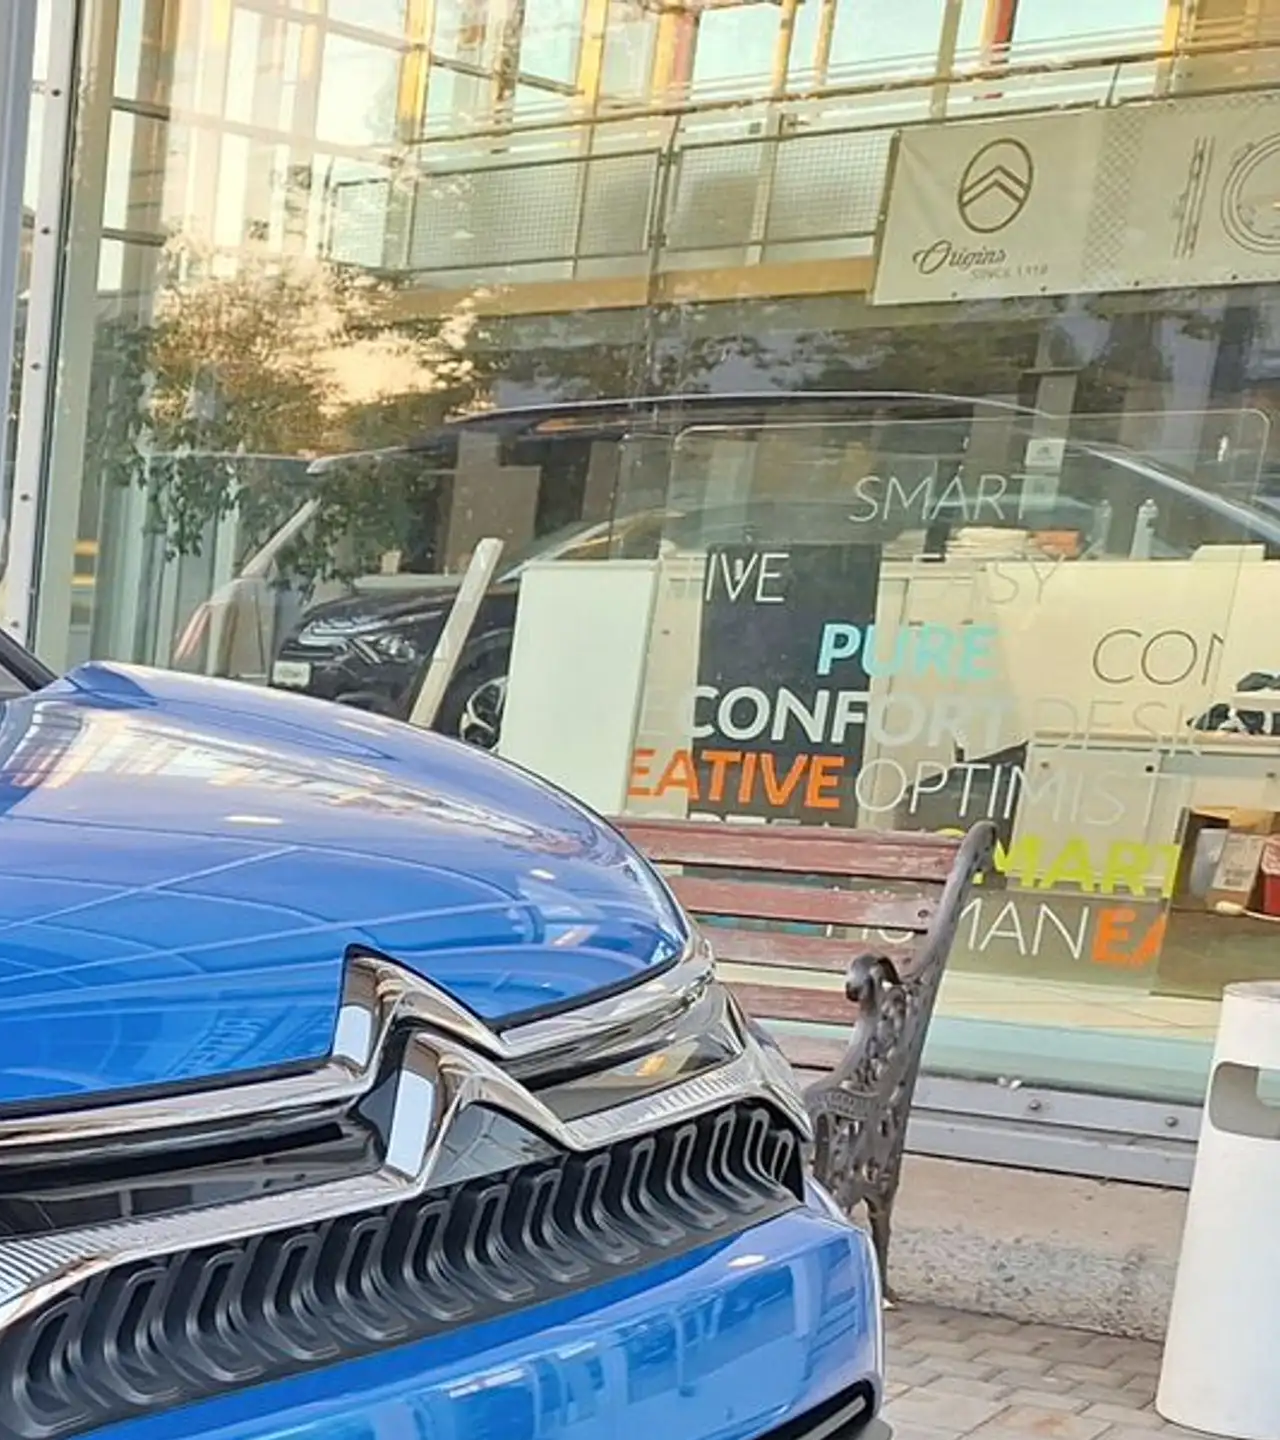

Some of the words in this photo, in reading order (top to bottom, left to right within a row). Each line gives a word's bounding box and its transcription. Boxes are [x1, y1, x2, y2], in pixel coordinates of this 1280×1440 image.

[912, 239, 1007, 276] Origins
[849, 474, 1048, 522] SMART
[817, 622, 996, 681] PURE
[680, 685, 1002, 750] CONFORT
[628, 748, 845, 810] EATIVE
[970, 829, 1181, 899] MART
